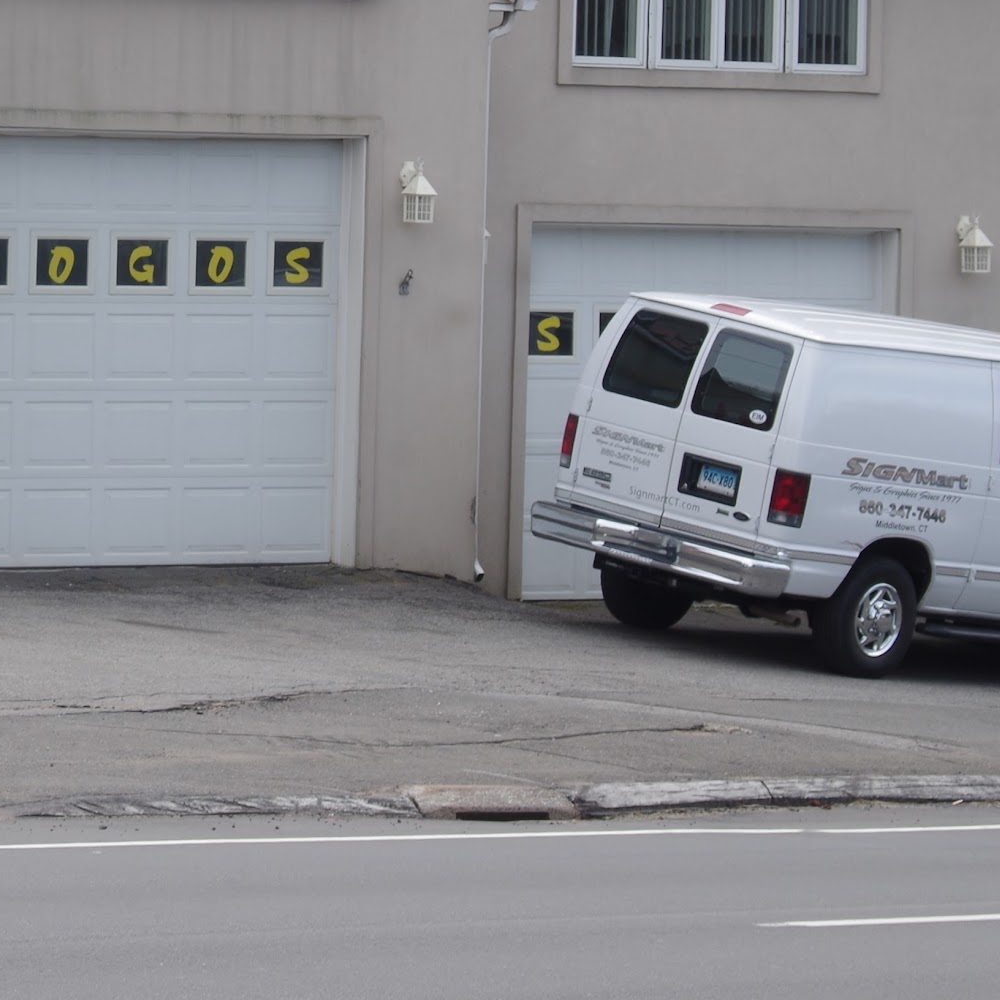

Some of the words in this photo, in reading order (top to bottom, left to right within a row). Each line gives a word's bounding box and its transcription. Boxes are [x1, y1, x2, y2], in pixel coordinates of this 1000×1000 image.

[841, 457, 969, 490] SIGNMart
[629, 485, 701, 512] SignmartCT.com
[941, 494, 962, 504] 1977
[875, 520, 917, 533] Middletown,
[918, 525, 929, 533] CT
